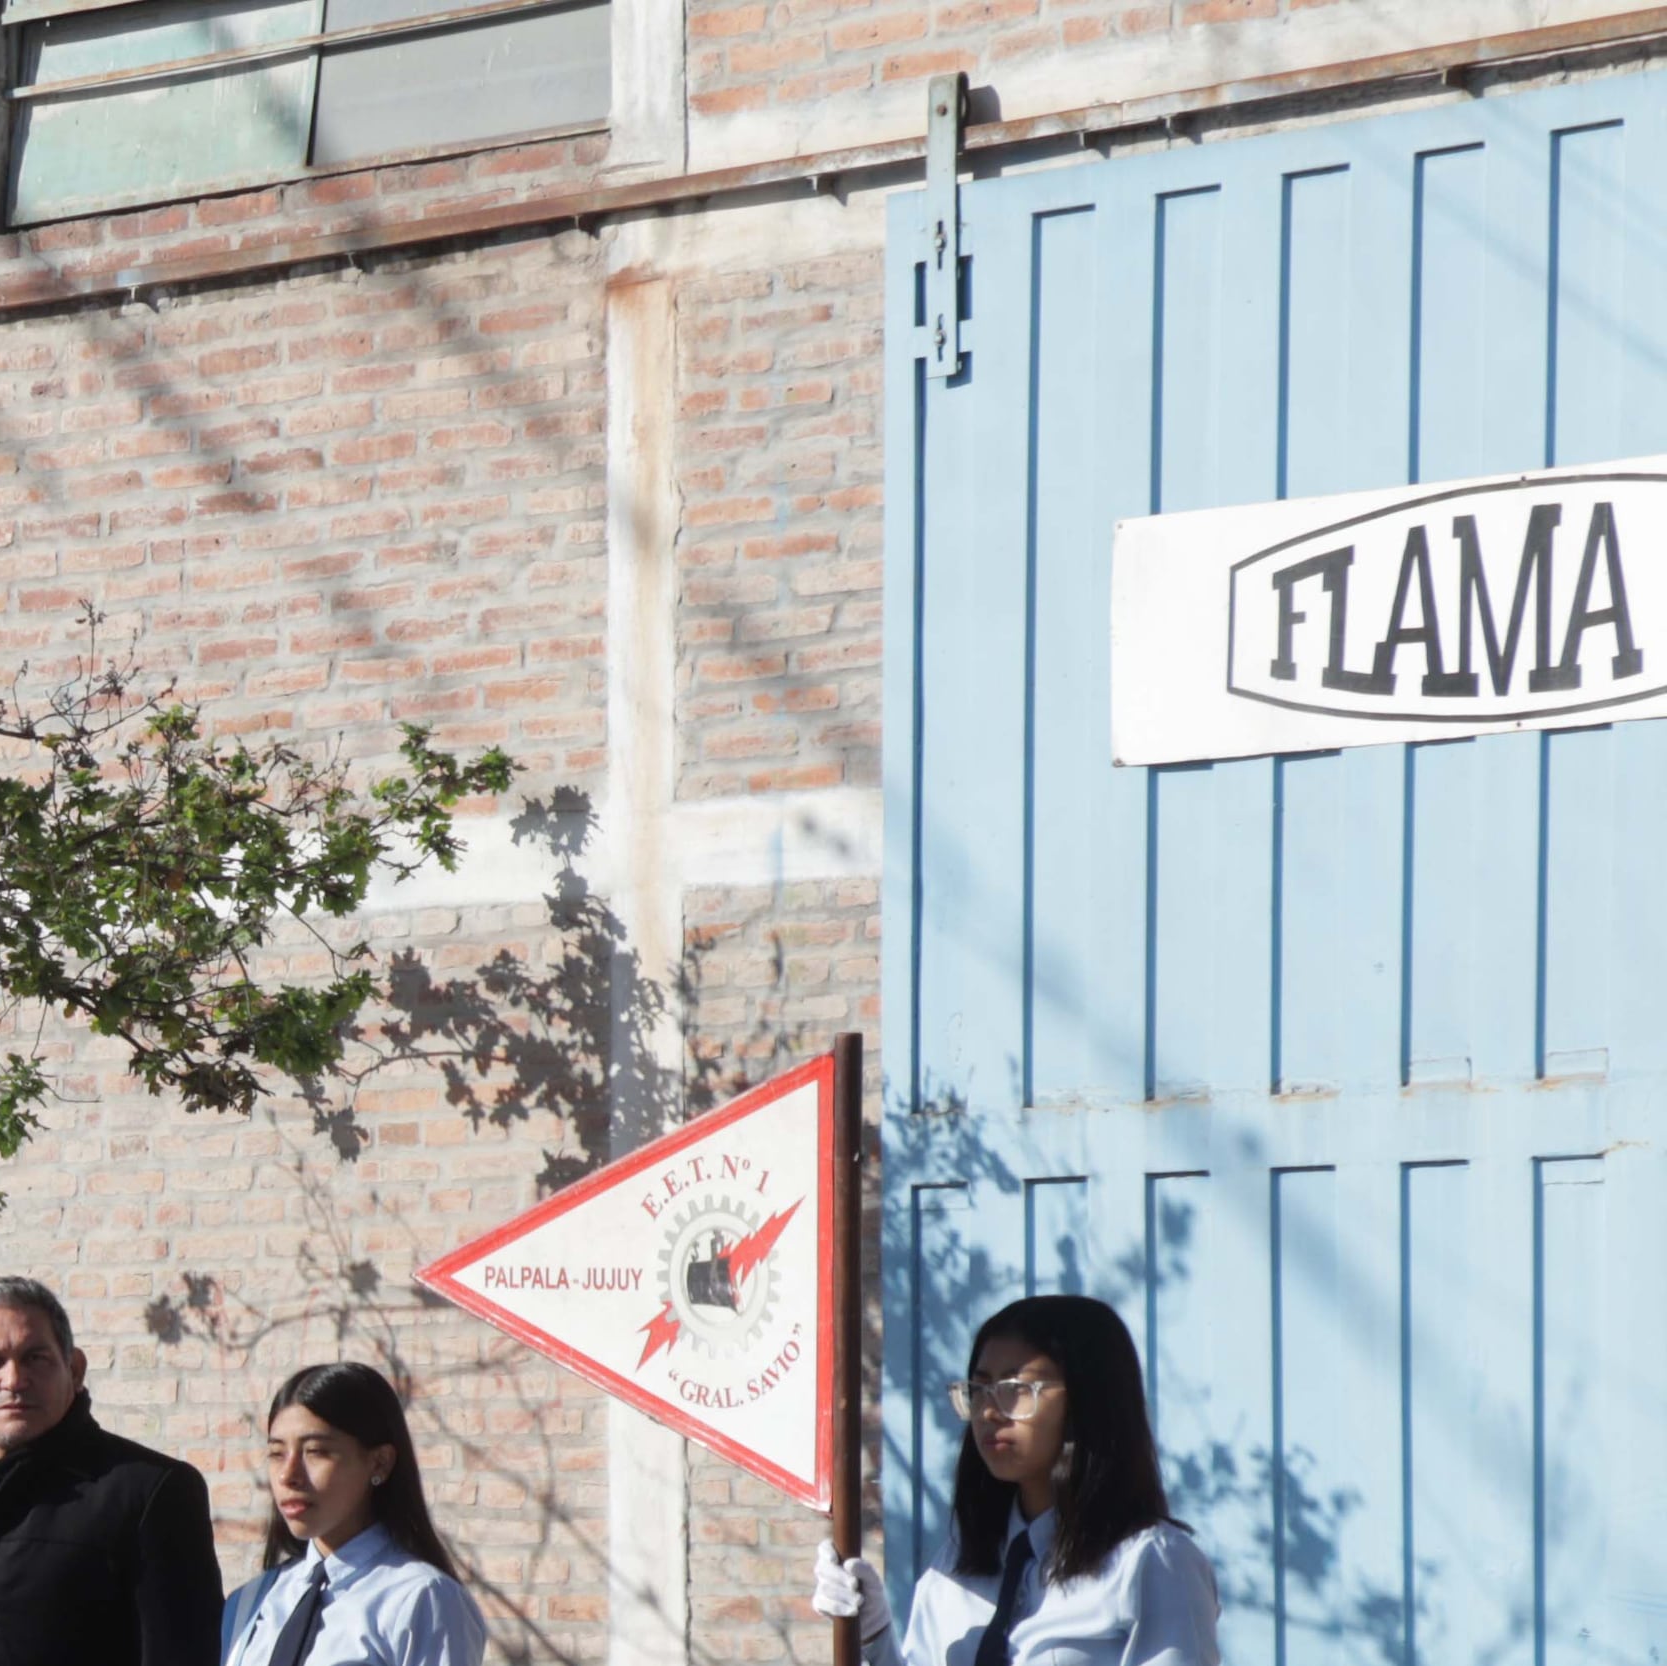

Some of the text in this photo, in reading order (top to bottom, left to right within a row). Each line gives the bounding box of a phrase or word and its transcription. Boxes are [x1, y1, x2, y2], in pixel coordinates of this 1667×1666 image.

[1270, 502, 1643, 697] FLAMA
[641, 1156, 712, 1221] E.E.T.
[755, 1170, 770, 1194] 1
[484, 1266, 569, 1289] PALPALA
[582, 1267, 643, 1291] JUJUY
